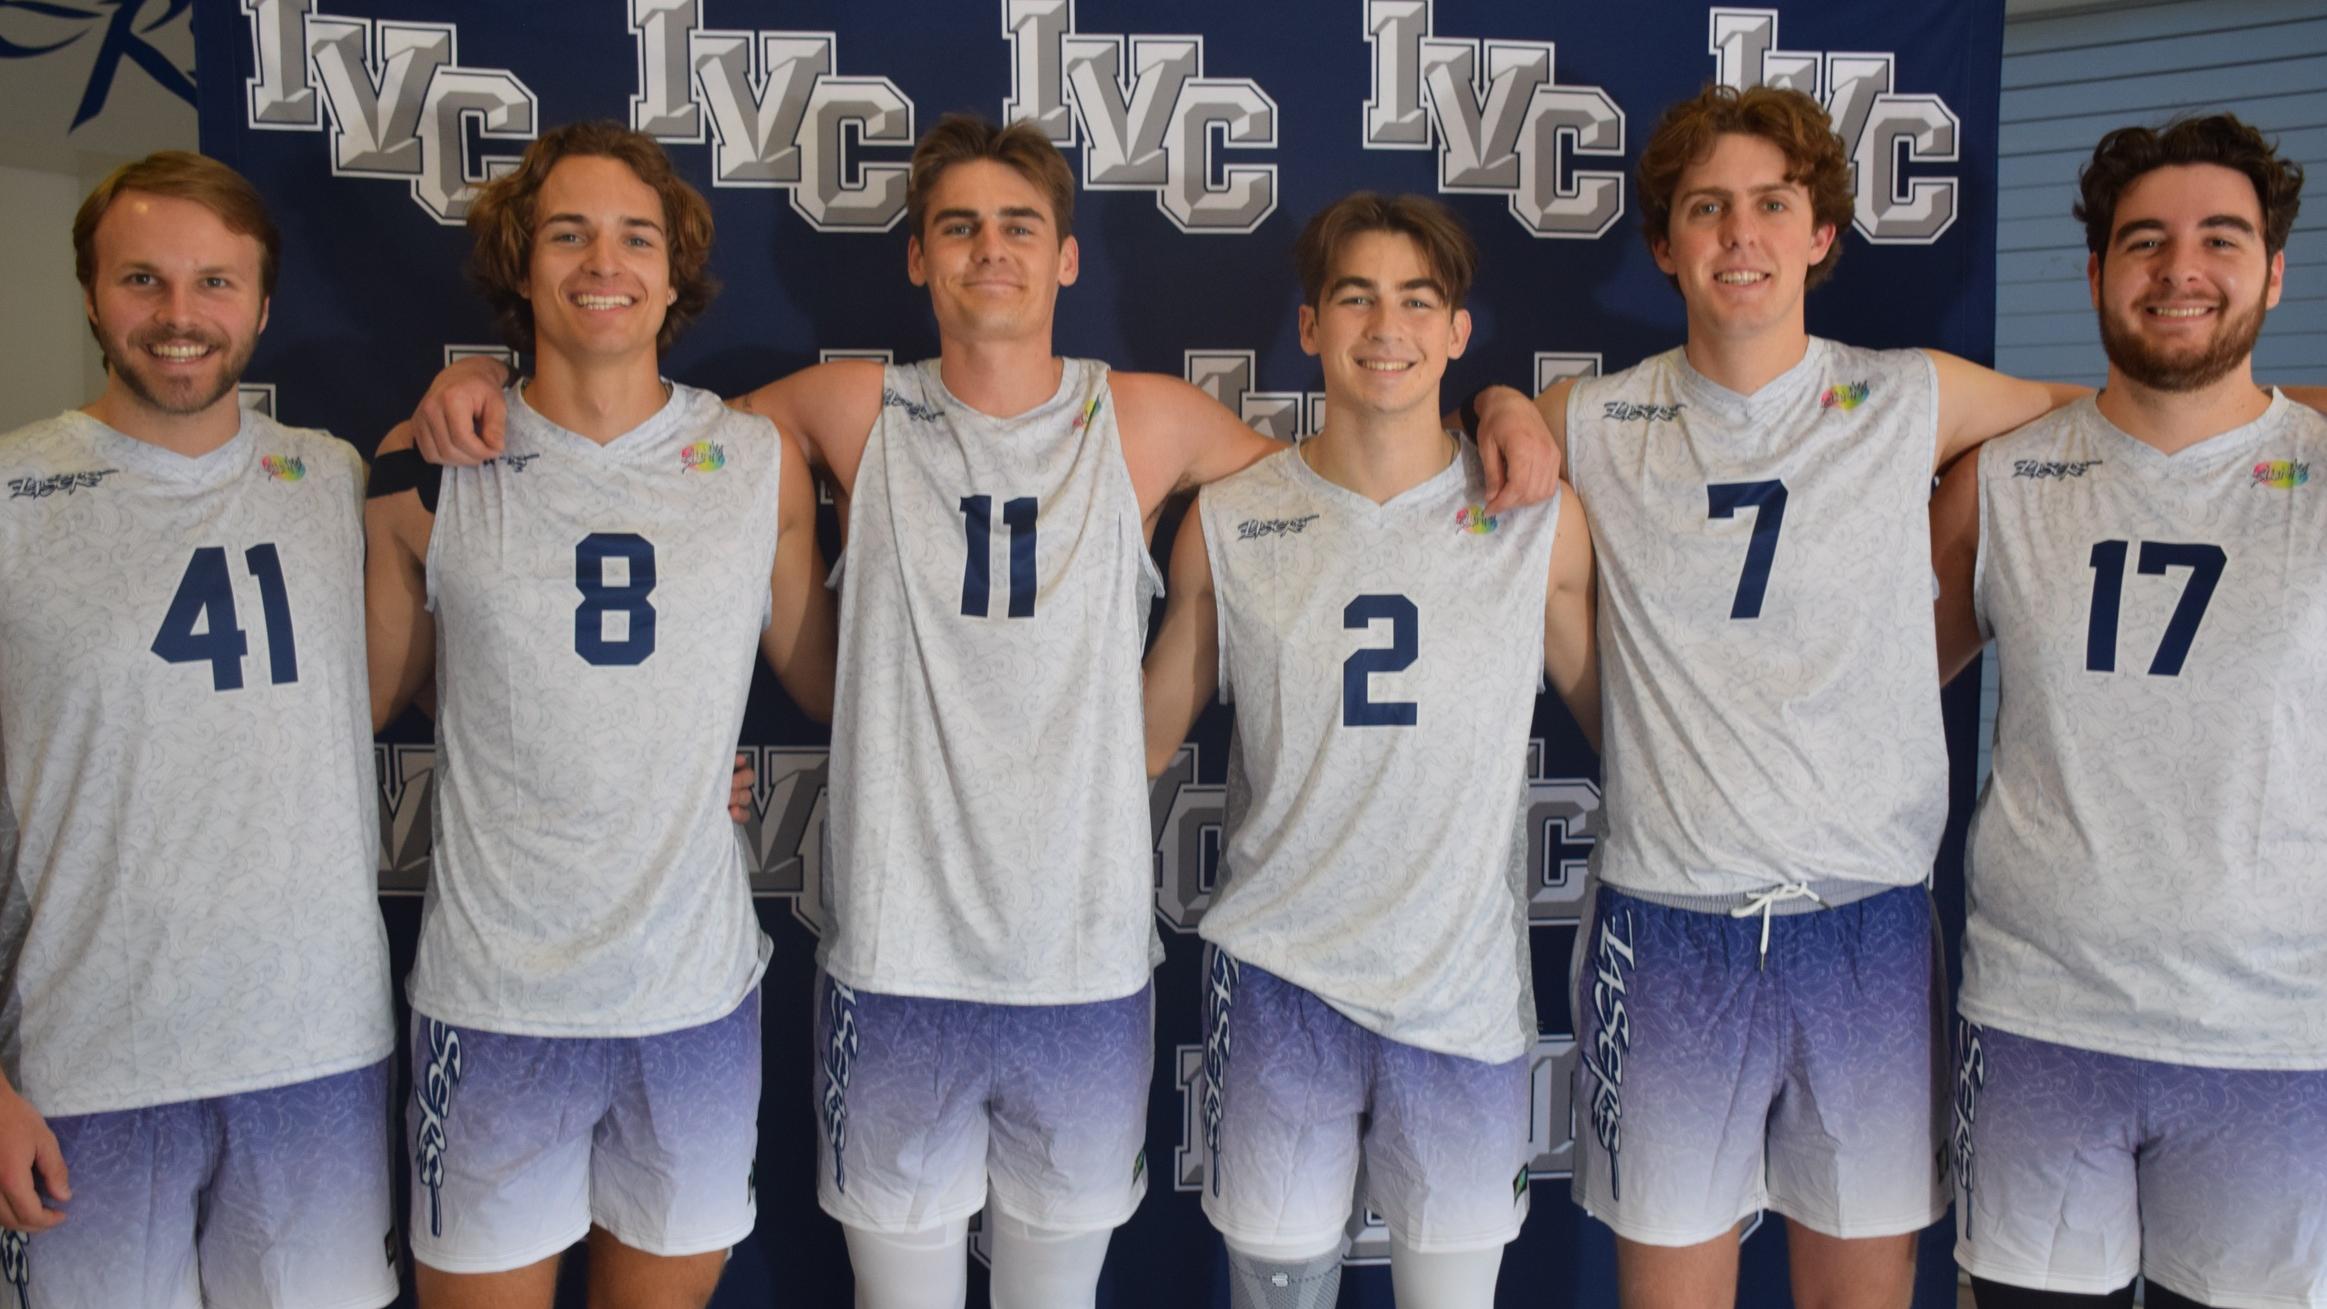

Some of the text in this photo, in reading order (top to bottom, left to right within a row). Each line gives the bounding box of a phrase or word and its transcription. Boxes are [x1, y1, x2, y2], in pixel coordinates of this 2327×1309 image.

[241, 0, 538, 225] IVC
[628, 0, 915, 233] IVC
[1002, 0, 1279, 234] IVC
[1361, 0, 1625, 239] IVC
[150, 542, 299, 692] 41
[574, 532, 656, 667] 8
[960, 495, 1038, 618] 11
[1706, 478, 1789, 620] 7
[2085, 539, 2228, 677] 17
[1343, 594, 1419, 728] 2
